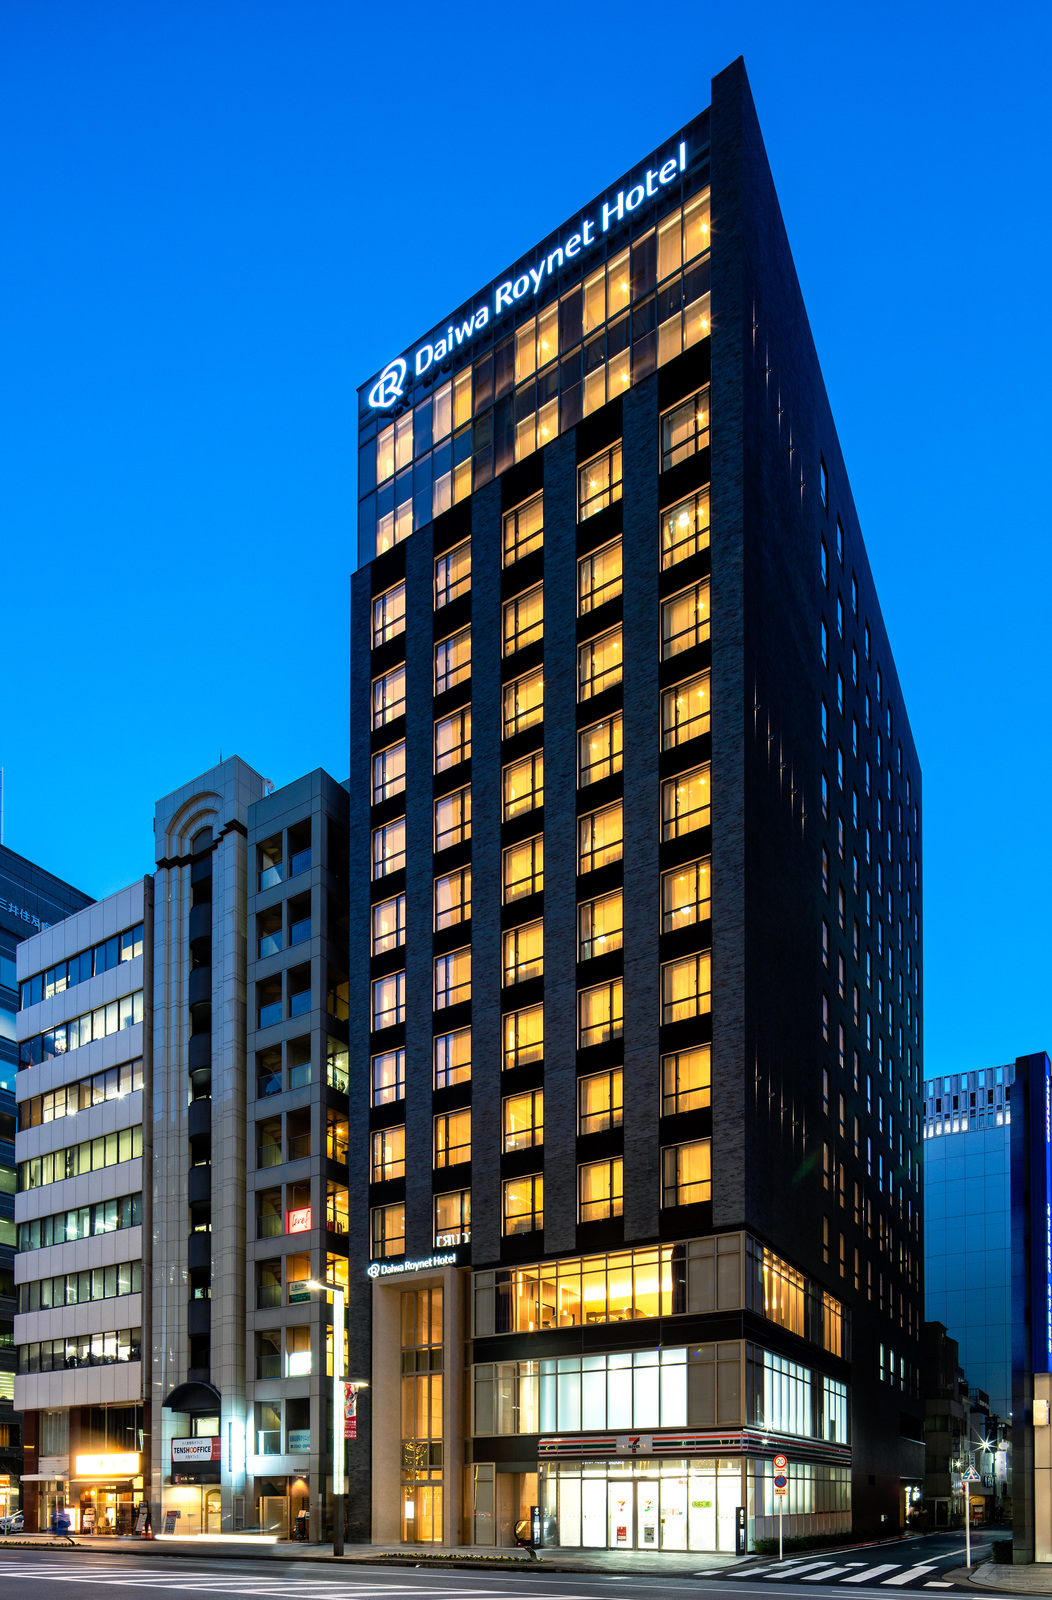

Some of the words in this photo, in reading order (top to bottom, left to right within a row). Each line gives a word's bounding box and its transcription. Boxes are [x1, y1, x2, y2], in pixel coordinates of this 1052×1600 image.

[415, 305, 489, 376] Daiwa
[495, 219, 595, 315] Roynet
[602, 141, 687, 231] Hotel
[381, 1263, 404, 1275] Daiwa
[404, 1257, 432, 1271] Roynet
[433, 1253, 456, 1266] Hotel
[912, 1491, 921, 1502] P
